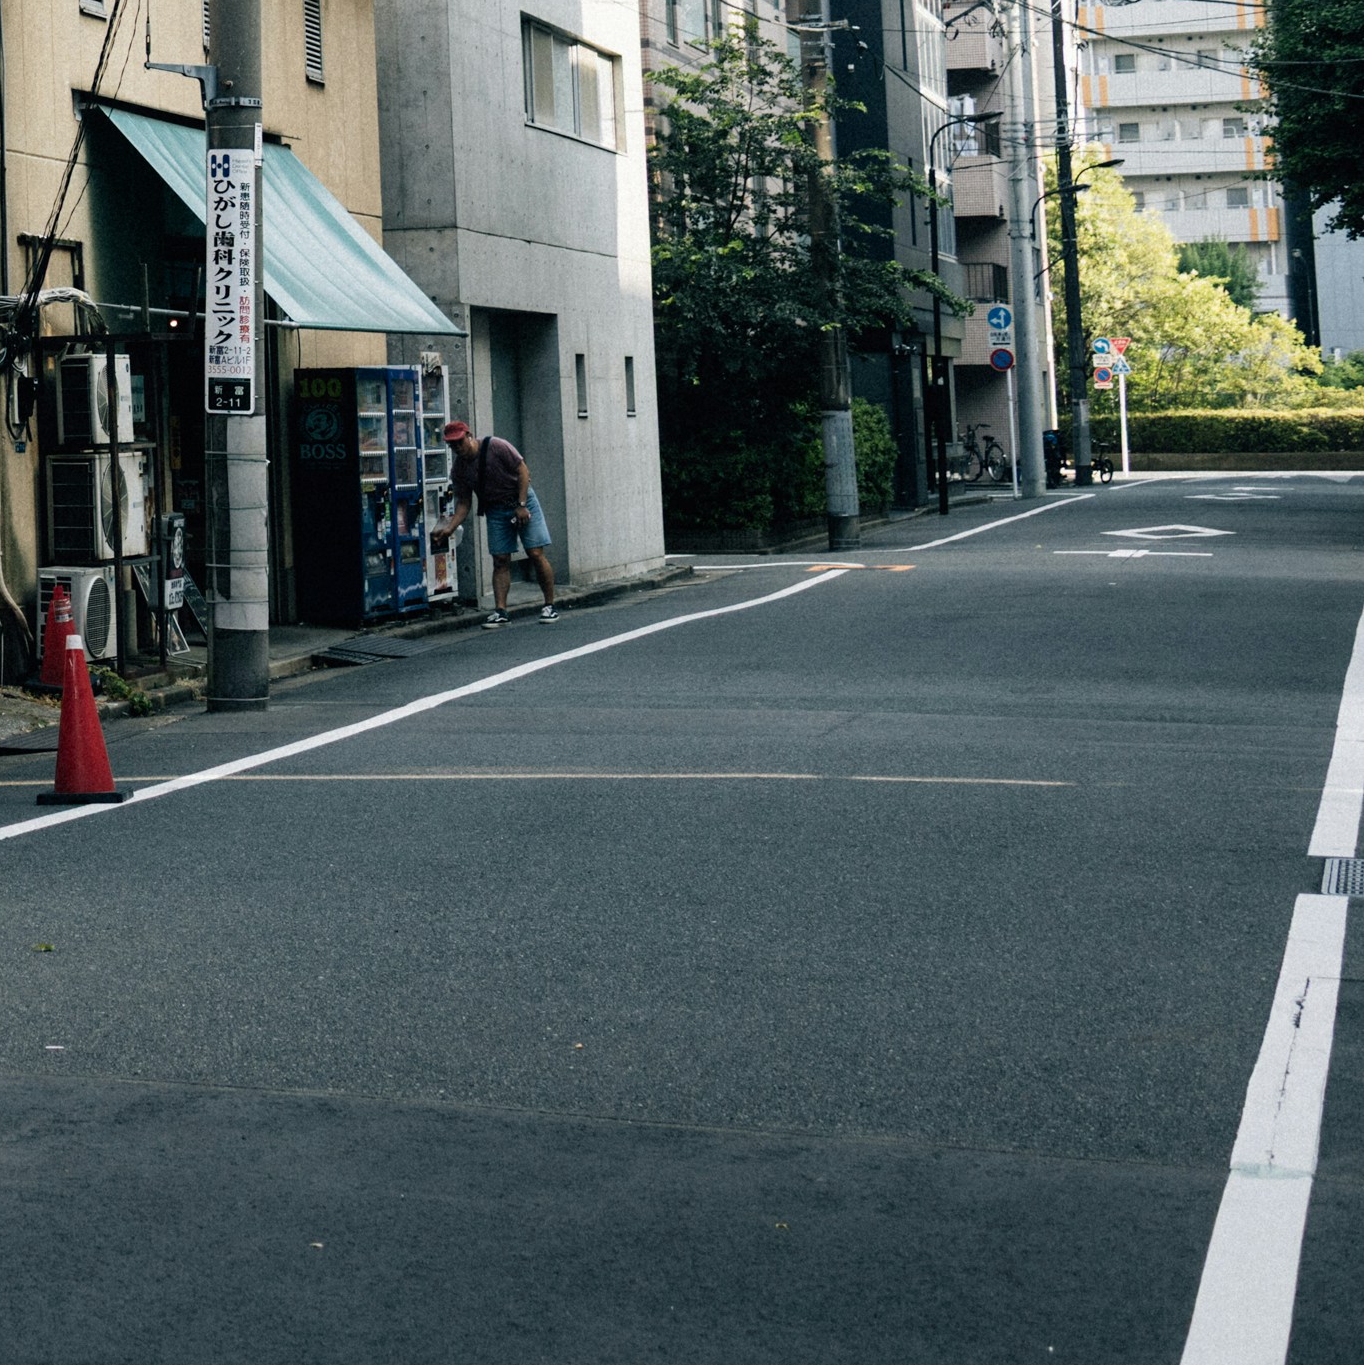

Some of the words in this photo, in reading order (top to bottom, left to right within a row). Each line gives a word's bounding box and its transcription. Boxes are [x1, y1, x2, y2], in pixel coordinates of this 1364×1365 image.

[212, 179, 236, 345] ひがし歯科クリニック
[209, 345, 251, 356] 新富2-11-2
[207, 365, 252, 375] 3555-0012
[299, 378, 342, 398] 100
[216, 397, 241, 407] 2-11
[299, 443, 347, 460] BOSS
